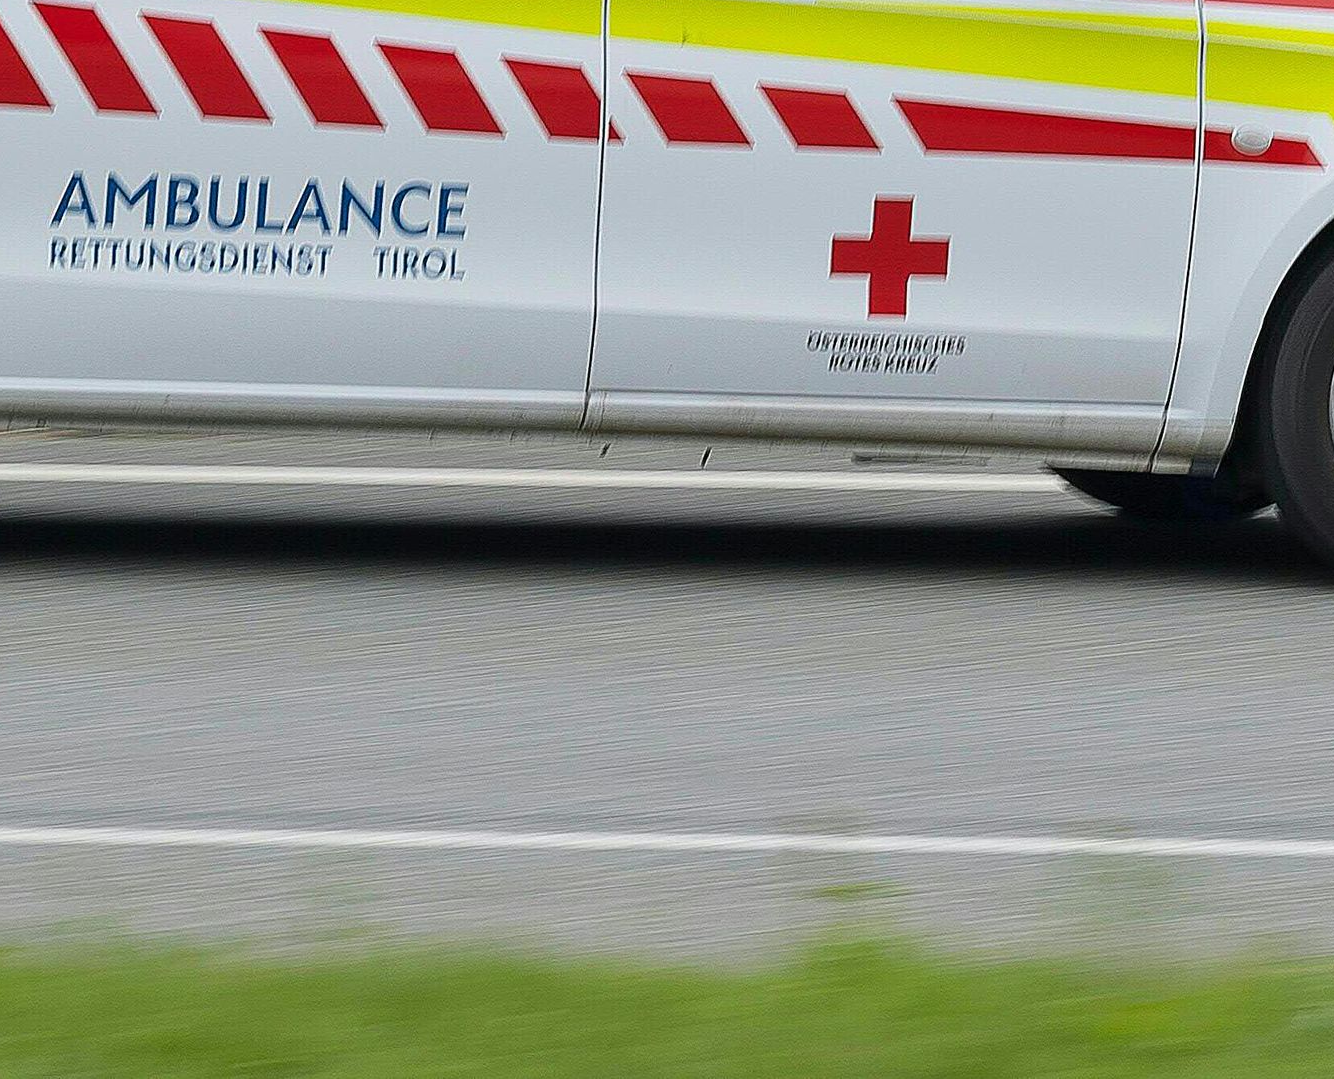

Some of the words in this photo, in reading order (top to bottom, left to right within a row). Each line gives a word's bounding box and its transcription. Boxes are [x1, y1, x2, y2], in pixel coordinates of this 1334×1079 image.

[49, 169, 469, 240] AMBULANCE
[48, 235, 333, 278] RETTUNGSDIENST
[373, 245, 466, 282] TIROL
[828, 353, 881, 373] ROTES
[883, 355, 939, 375] KREUZ
